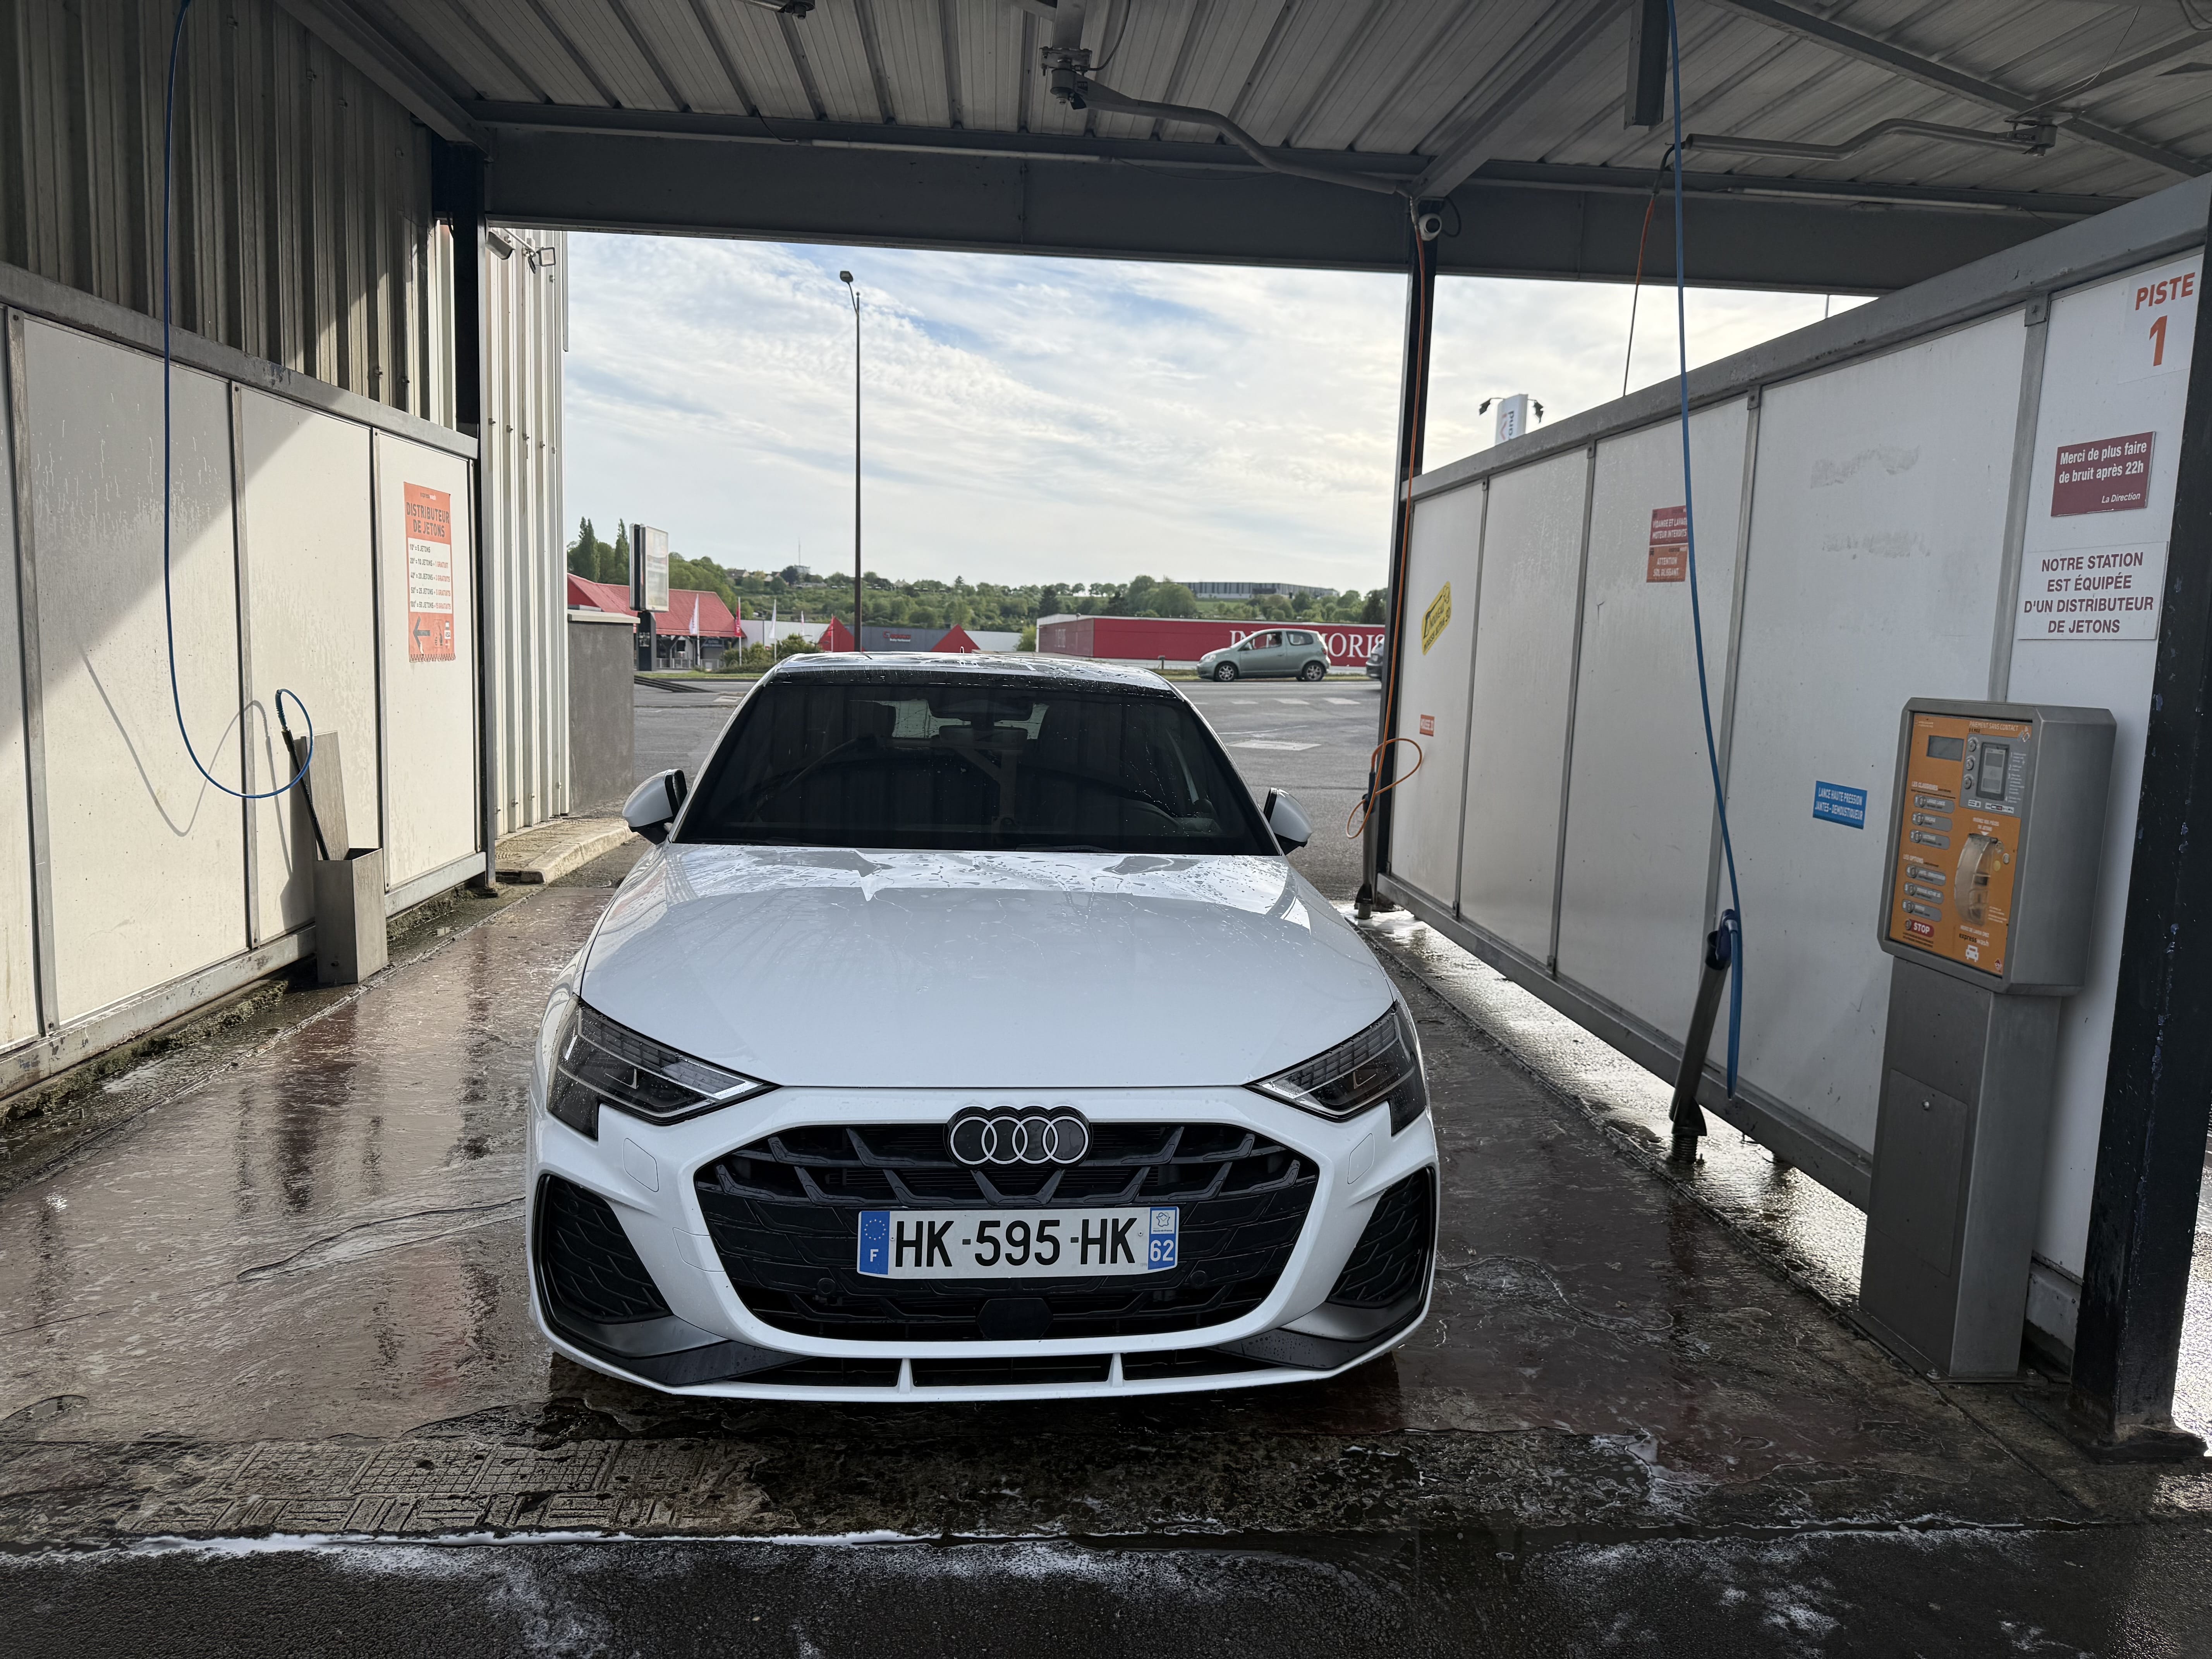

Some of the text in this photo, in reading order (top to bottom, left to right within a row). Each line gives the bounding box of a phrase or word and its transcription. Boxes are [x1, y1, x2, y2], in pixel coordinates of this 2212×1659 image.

[2135, 272, 2195, 310] PISTE
[2149, 315, 2168, 366] 1
[2060, 441, 2147, 465] Merci de plus faire
[2059, 460, 2143, 484] de bruit après 22h
[2101, 491, 2140, 503] La Direction
[406, 502, 449, 524] DISTRIBUTEUR
[413, 519, 445, 537] DE JETONS
[1653, 517, 1687, 528] VIDANGE ET LAVAG
[1652, 529, 1687, 539] MOTEUR INTERDITS
[1657, 557, 1677, 565] ATTENTION
[2042, 552, 2143, 572] NOTRE STATION
[1661, 568, 1679, 576] GLISSANT
[2047, 572, 2132, 592] EST ÉQUIPÉE
[2024, 596, 2154, 613] D'UN DISTRIBUTEUR
[2048, 619, 2120, 634] DE JETONS
[1818, 787, 1863, 806] LANCE HAUTE PRESSION
[1815, 801, 1829, 812] JANTES
[1913, 922, 1930, 934] STOP
[1959, 933, 1989, 947] expresswash
[895, 1218, 1137, 1267] HK-595-HK
[1150, 1240, 1174, 1262] 62
[870, 1249, 879, 1262] F
